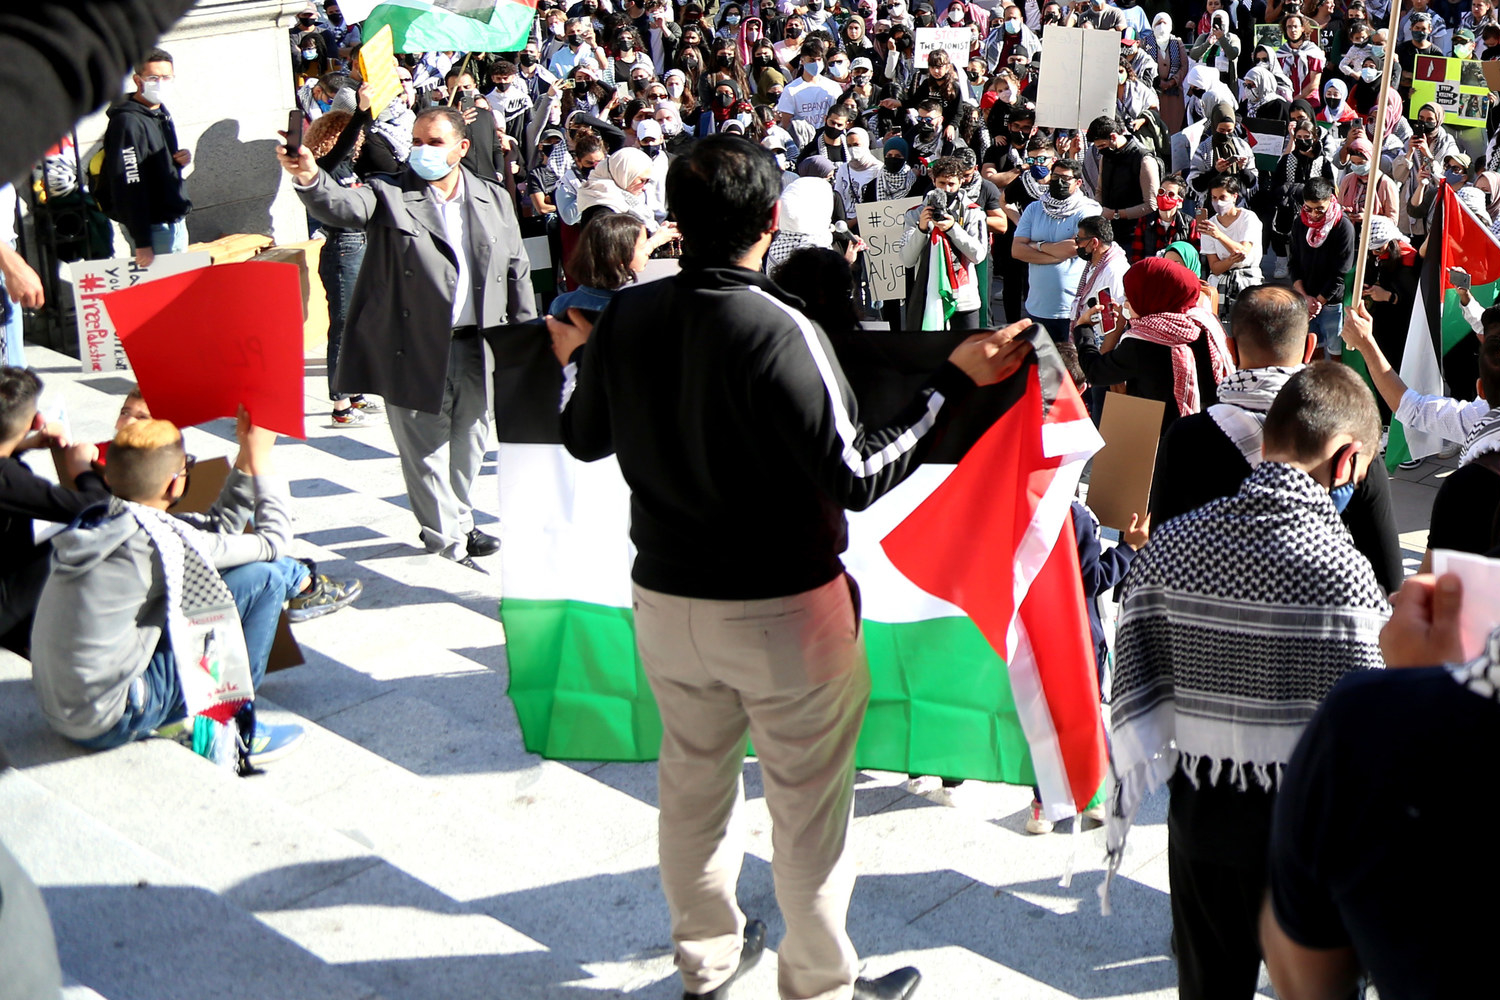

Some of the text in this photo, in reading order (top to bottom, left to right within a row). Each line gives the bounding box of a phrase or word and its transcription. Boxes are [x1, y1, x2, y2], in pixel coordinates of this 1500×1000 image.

[920, 41, 968, 50] THE ZIONIST
[507, 97, 528, 109] NIKE
[121, 146, 141, 184] VIRTUE
